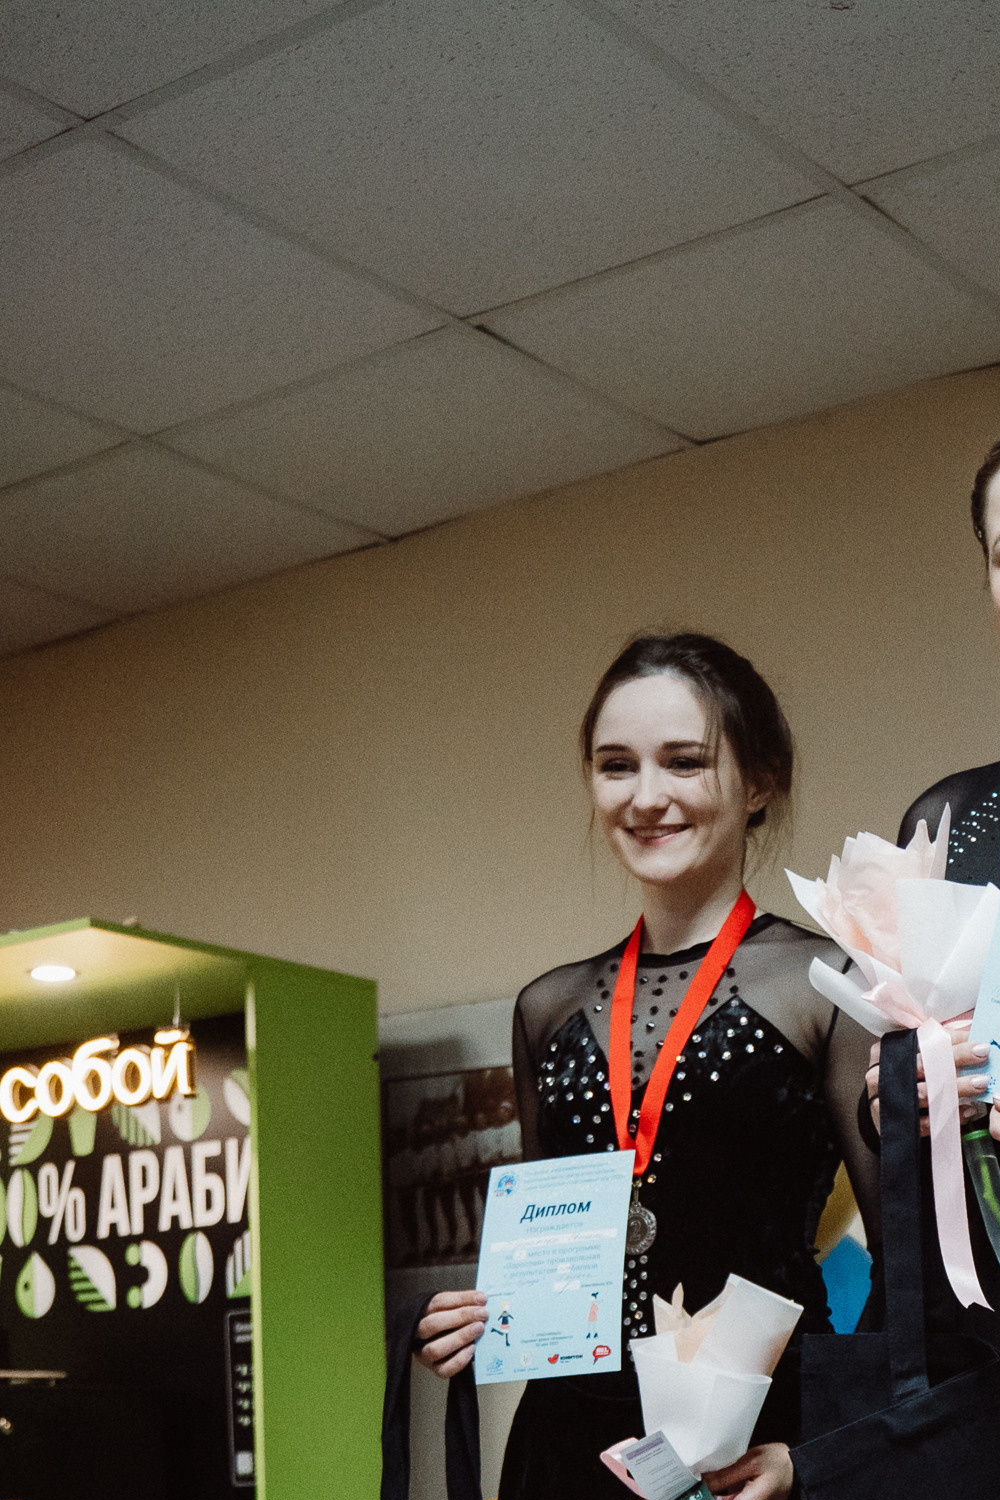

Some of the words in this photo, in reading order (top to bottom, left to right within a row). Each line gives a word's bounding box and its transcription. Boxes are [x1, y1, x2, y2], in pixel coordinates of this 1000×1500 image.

[1, 1029, 195, 1122] собой
[96, 1138, 251, 1240] АРАБИ
[520, 1200, 592, 1224] Диплом
